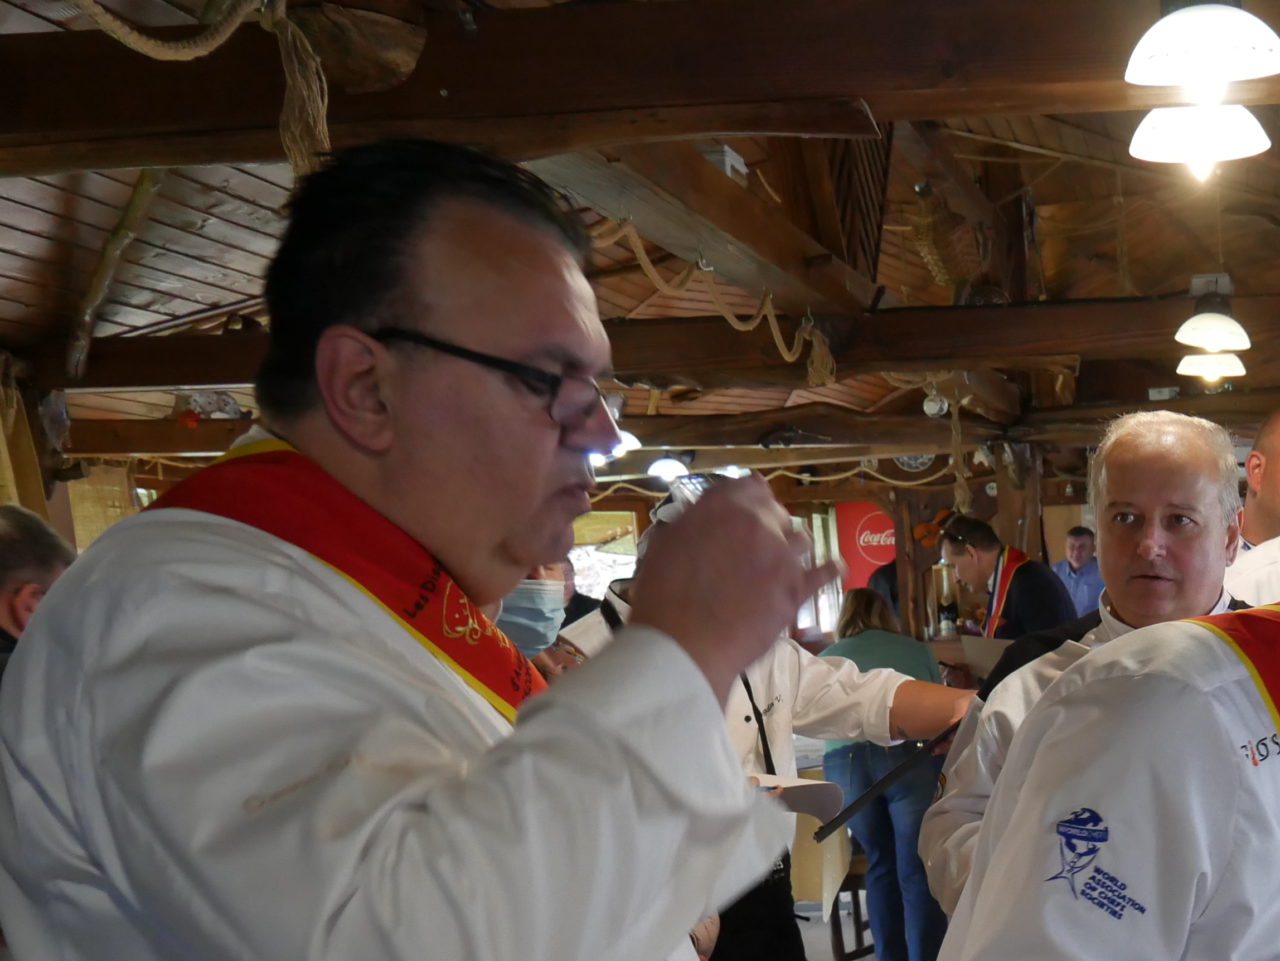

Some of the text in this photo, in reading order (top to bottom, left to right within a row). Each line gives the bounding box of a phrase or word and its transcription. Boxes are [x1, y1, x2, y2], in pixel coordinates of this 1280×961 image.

[1084, 882, 1098, 892] OF
[1094, 865, 1127, 891] WORLD
[1080, 889, 1123, 920] SOCIETIES
[1088, 875, 1146, 914] ASSOCIATION
